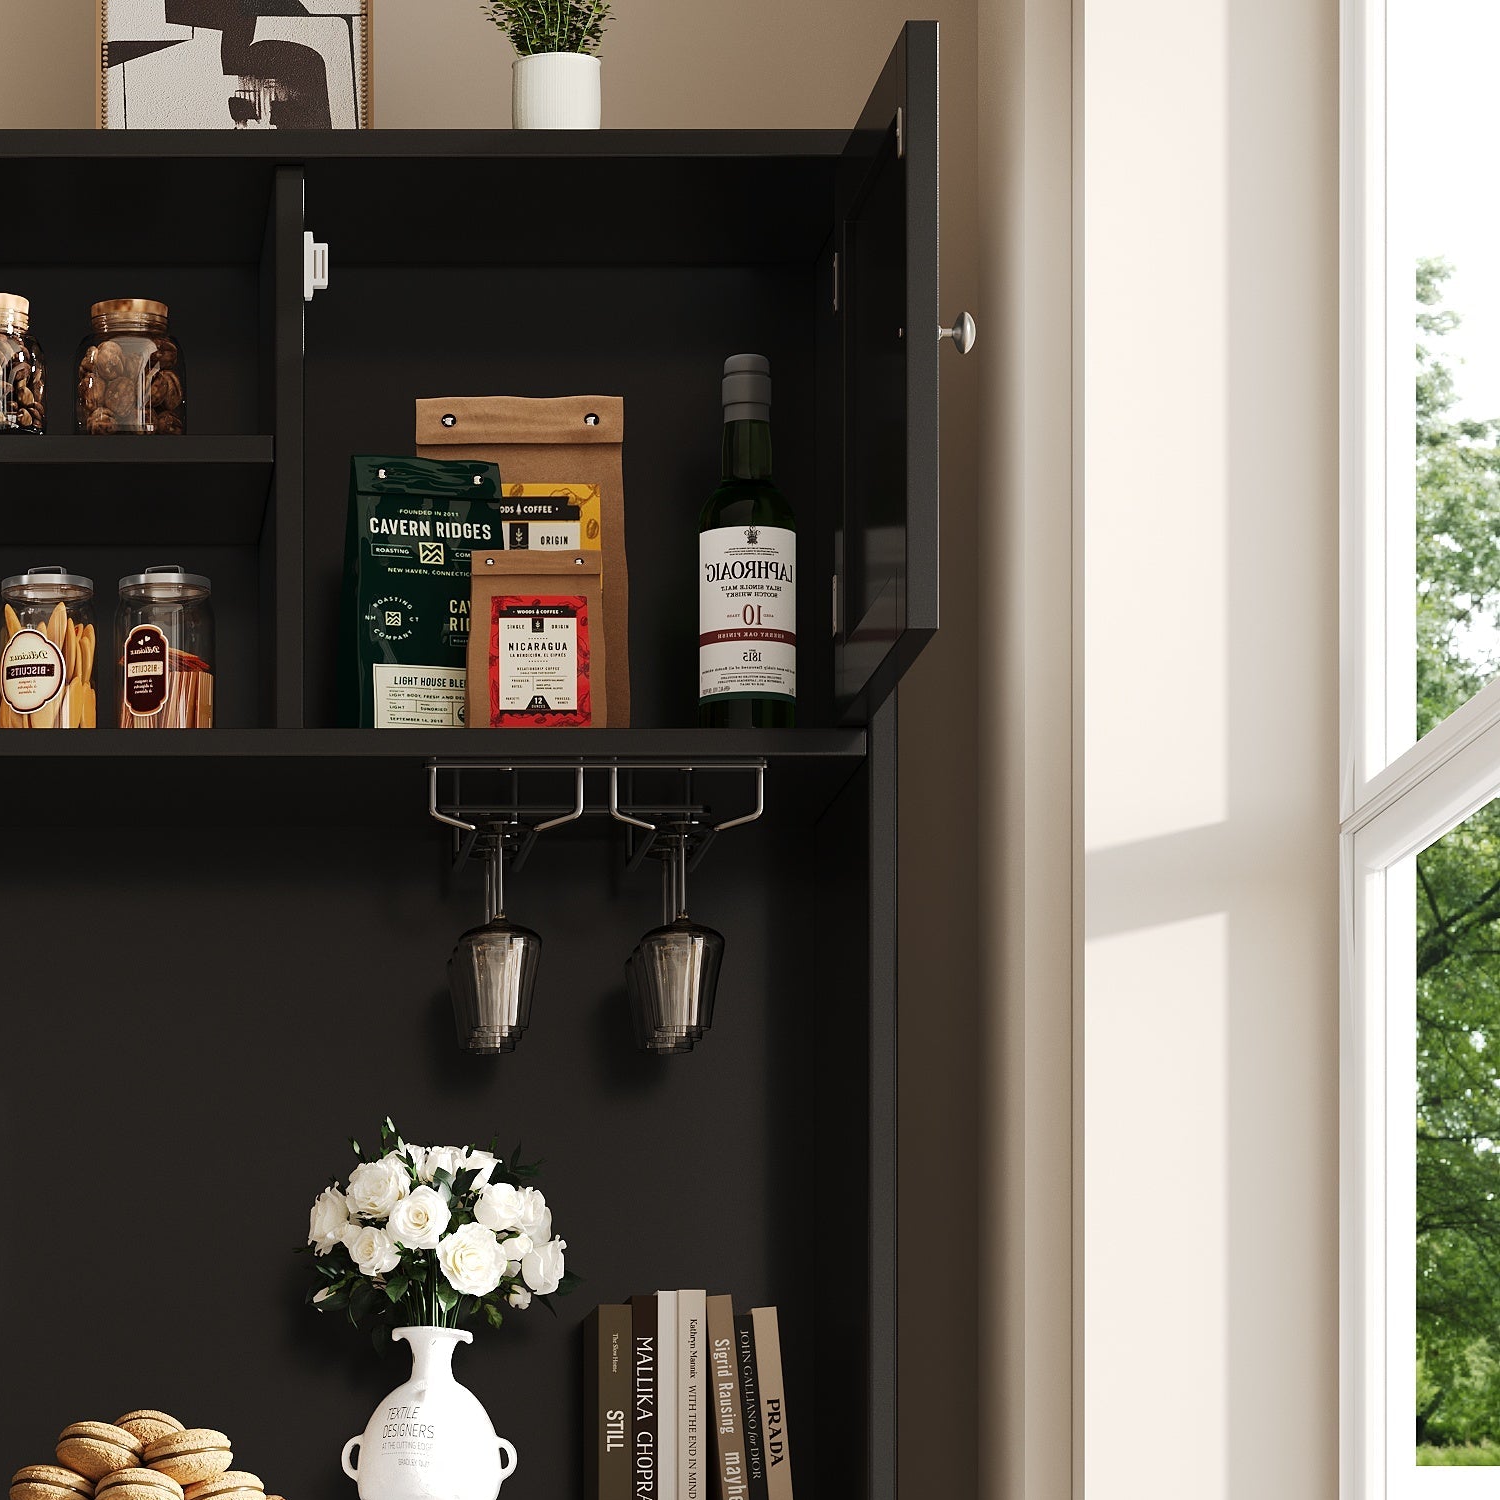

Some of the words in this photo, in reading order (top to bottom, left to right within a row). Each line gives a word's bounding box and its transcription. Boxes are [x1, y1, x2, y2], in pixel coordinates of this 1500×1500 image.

[399, 508, 432, 516] FOUNDED
[523, 505, 552, 514] COFFEE
[369, 517, 430, 537] CAVERN
[436, 521, 492, 541] RIDGES
[540, 535, 568, 545] ORIGIN
[375, 547, 410, 555] ROASTING
[372, 596, 413, 610] ROASTING
[373, 628, 413, 641] COMPANY
[508, 642, 568, 651] NICARAGUA
[393, 676, 418, 686] LIGHT
[420, 677, 447, 687] HOUSE
[533, 697, 543, 705] 12
[688, 1318, 698, 1349] Kathryn
[739, 1329, 752, 1363] JOHN
[689, 1350, 698, 1379] Mannix
[713, 1338, 733, 1377] Sigrid
[636, 1337, 653, 1421] MALLIKA
[688, 1385, 697, 1411] WITH
[743, 1365, 757, 1429] GALLIANO
[387, 1406, 421, 1421] TEXTILE
[718, 1383, 736, 1434] Rausing
[382, 1423, 435, 1439] DESIGNERS
[606, 1410, 624, 1452] STILL
[688, 1413, 697, 1433] THE
[766, 1398, 784, 1467] PRADA
[688, 1435, 697, 1456] END
[747, 1431, 759, 1446] for
[688, 1458, 697, 1469] IN
[749, 1447, 762, 1480] DIOR
[688, 1472, 697, 1499] MIND
